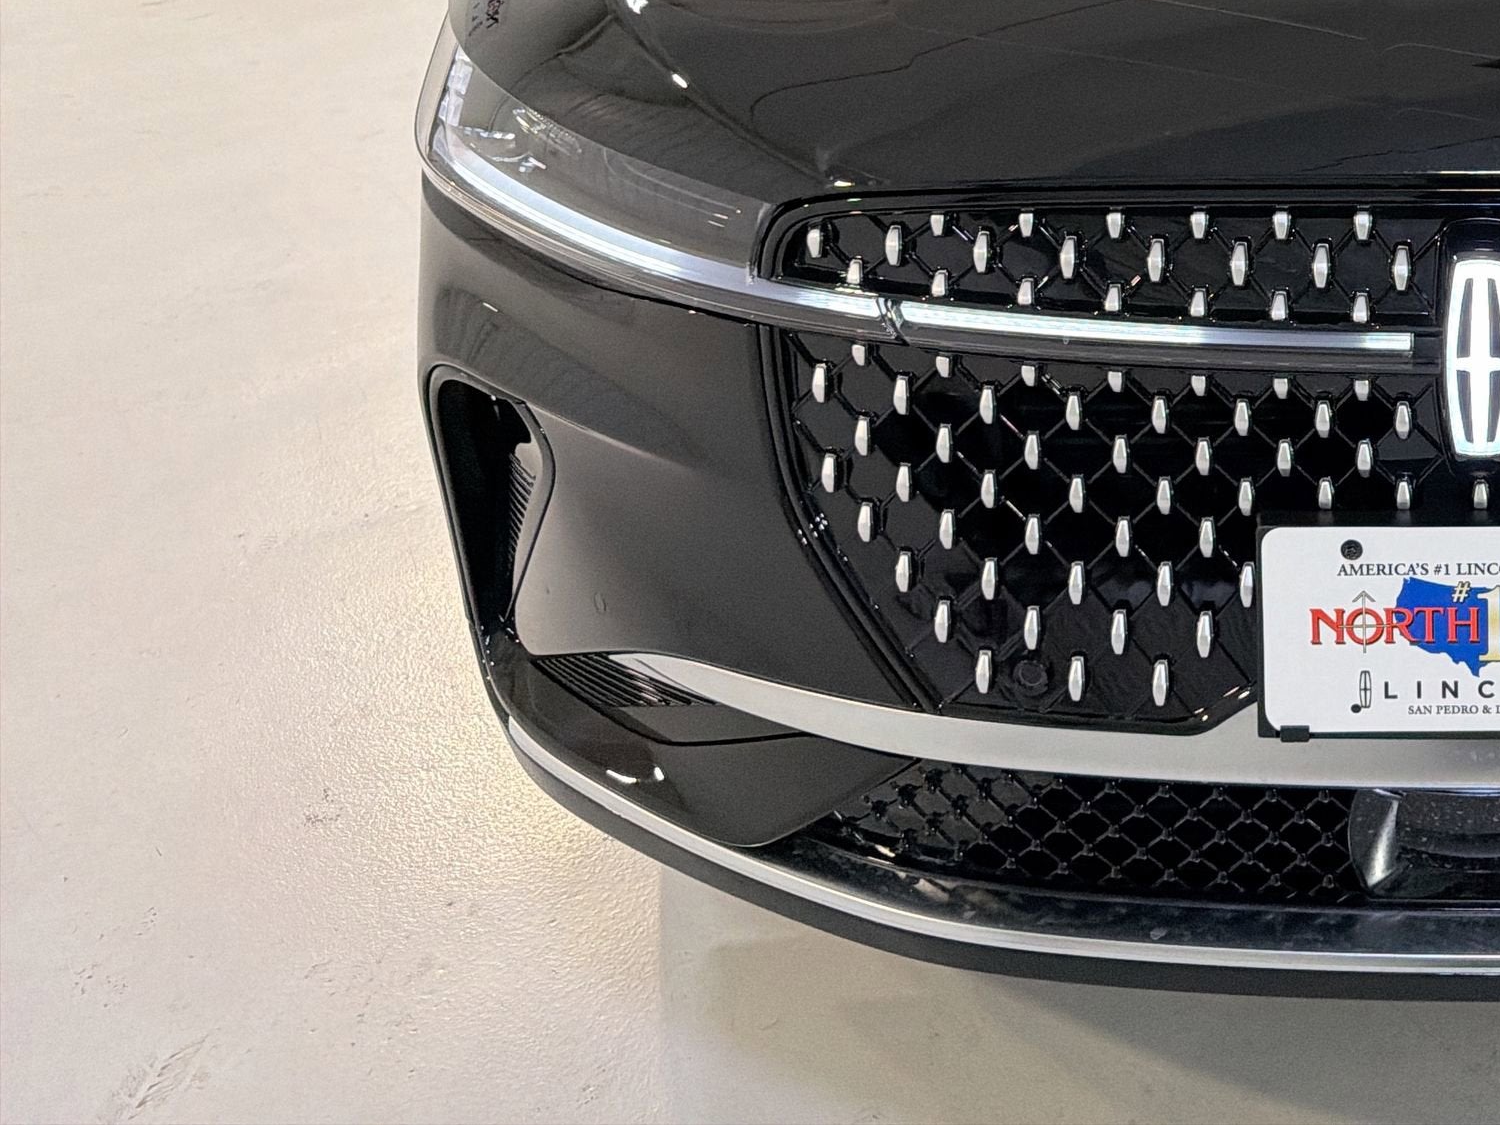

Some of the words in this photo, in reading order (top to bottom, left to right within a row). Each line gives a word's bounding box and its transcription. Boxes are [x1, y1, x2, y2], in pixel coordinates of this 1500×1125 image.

[1336, 563, 1429, 576] AMERICA'S
[1433, 563, 1451, 576] #1
[1309, 606, 1480, 646] NORTH
[1407, 704, 1433, 715] SAN
[1436, 704, 1481, 715] PEDRO
[1482, 704, 1492, 715] &
